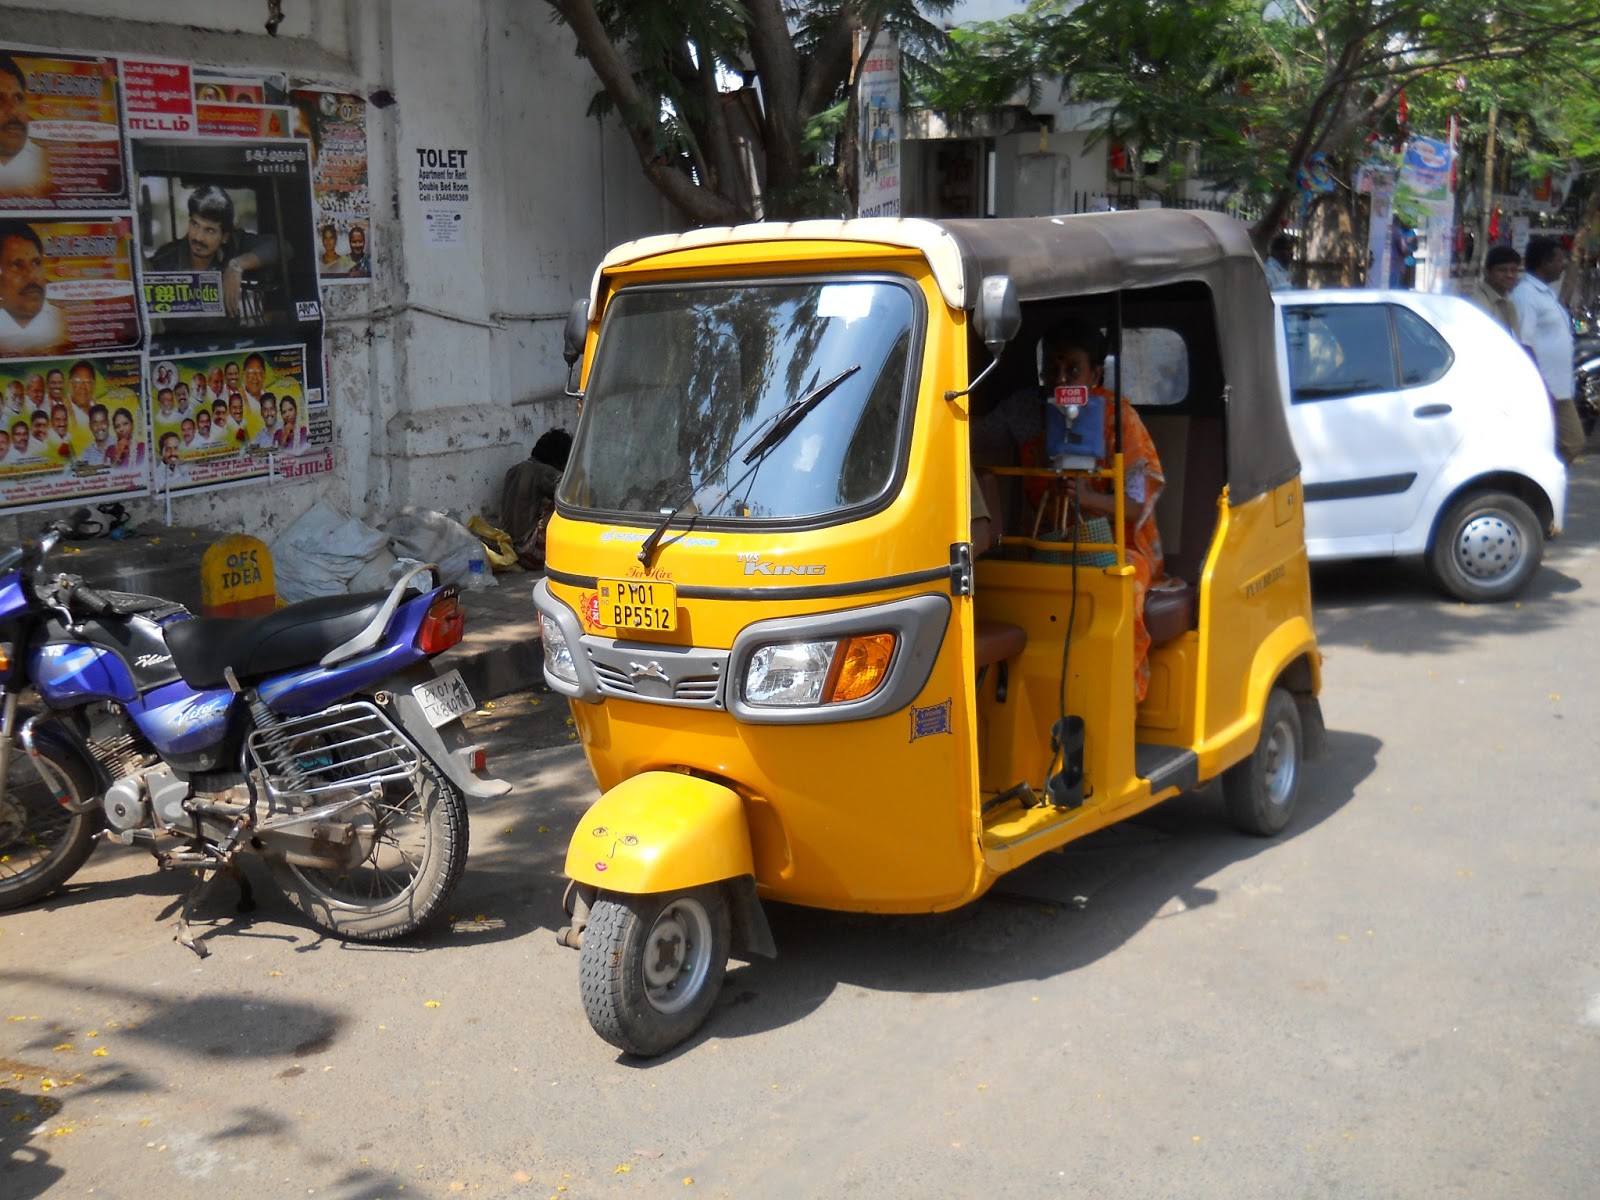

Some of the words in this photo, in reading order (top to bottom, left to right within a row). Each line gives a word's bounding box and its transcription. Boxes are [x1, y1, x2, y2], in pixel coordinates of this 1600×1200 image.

[419, 168, 446, 181] Apartment
[446, 169, 454, 180] for
[455, 169, 467, 180] Rent
[419, 181, 439, 191] Double
[440, 181, 452, 191] Bed
[453, 182, 469, 192] Room
[419, 193, 431, 201] Cell
[202, 284, 219, 302] dts
[1061, 388, 1081, 396] FOR
[1060, 396, 1083, 404] HIRE
[737, 552, 760, 562] TVS
[222, 567, 262, 589] IDEA
[626, 566, 644, 578] For
[648, 566, 672, 580] Hire
[617, 583, 653, 605] PY01
[614, 605, 670, 629] BP5512
[135, 654, 172, 668] Victor
[168, 700, 221, 726] Victor
